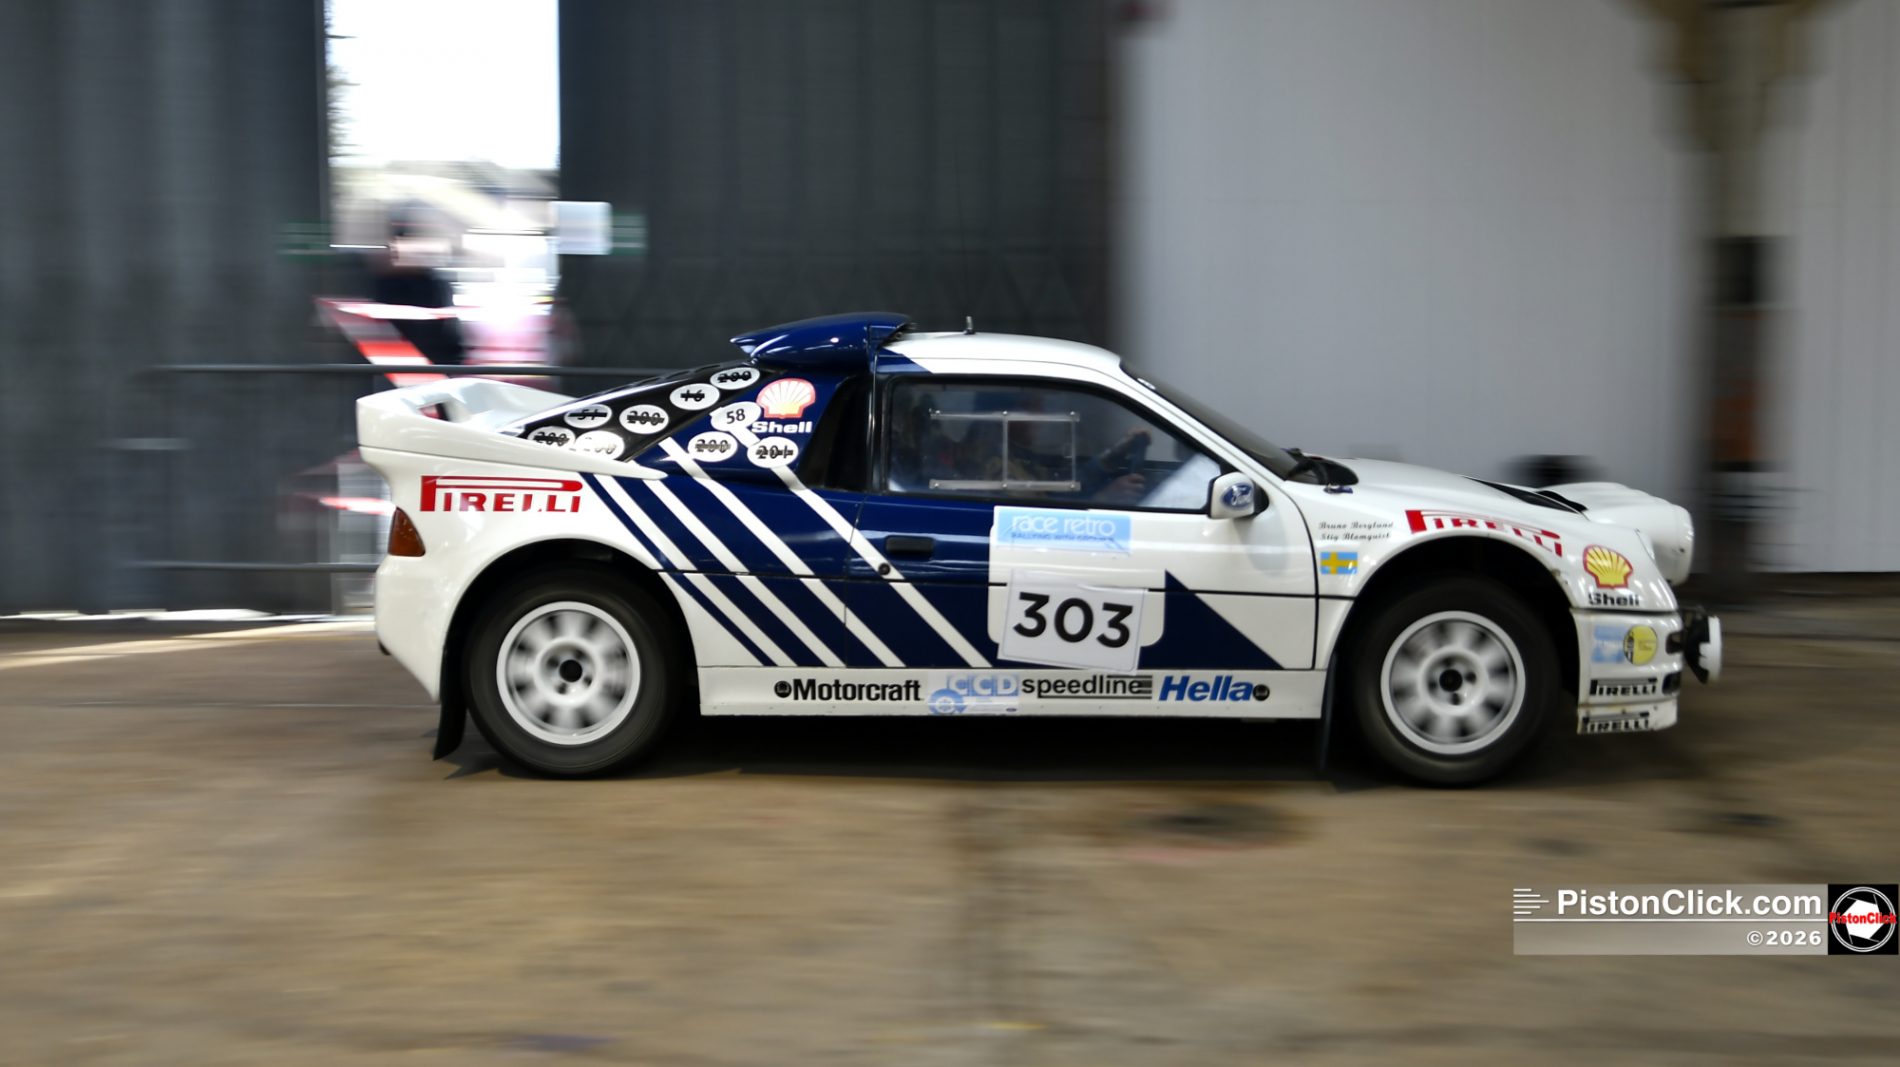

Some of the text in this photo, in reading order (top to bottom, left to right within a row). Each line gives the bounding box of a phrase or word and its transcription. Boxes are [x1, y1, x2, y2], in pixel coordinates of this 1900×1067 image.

[726, 408, 746, 424] 58
[752, 421, 812, 433] Shell
[420, 475, 583, 513] PIRELLI
[1012, 515, 1116, 536] race retro
[1405, 509, 1563, 557] PIRELLI
[1588, 592, 1640, 606] Shell
[1013, 592, 1133, 648] 303
[793, 679, 921, 701] Motorcraft
[949, 674, 1018, 695] CCD
[1021, 675, 1148, 699] speedline
[1158, 676, 1253, 701] Hella
[1589, 677, 1658, 696] PIRELLI
[1583, 711, 1650, 732] PIRELLI
